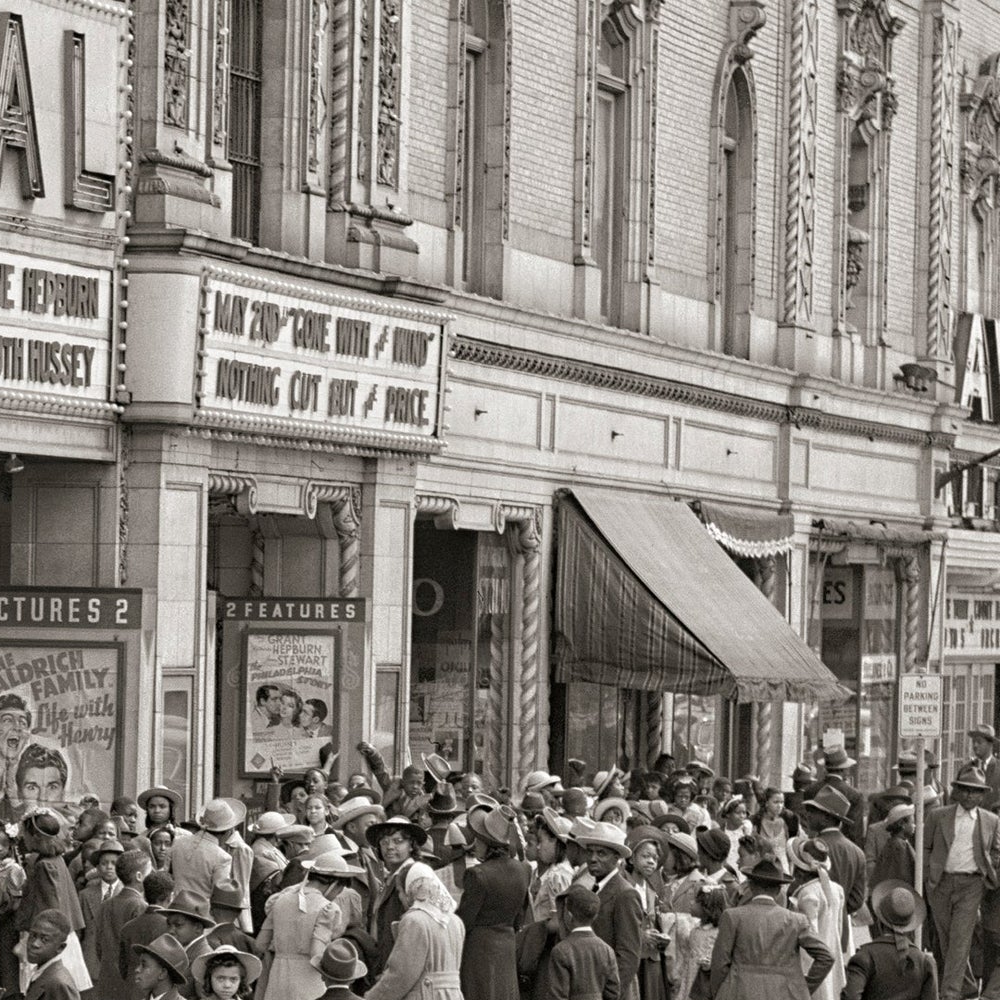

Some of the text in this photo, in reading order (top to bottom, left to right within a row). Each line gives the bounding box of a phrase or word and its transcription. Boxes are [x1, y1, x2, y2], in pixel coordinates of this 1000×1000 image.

[22, 267, 99, 319] HEPBURN
[214, 290, 249, 336] MAY
[249, 300, 280, 343] 2ND
[336, 317, 371, 359] WITH
[28, 339, 96, 387] HUSSEY
[955, 312, 1000, 424] A
[216, 358, 281, 407] NOTHING
[328, 378, 358, 417] BUT
[384, 386, 429, 427] PRICE
[822, 581, 846, 605] ES
[115, 599, 128, 624] 2
[226, 603, 356, 619] 2 FEATURES
[267, 635, 305, 645] GRANT
[273, 644, 322, 655] HEPBURN
[278, 655, 327, 666] STEWART
[31, 667, 110, 701] FAMILY
[251, 668, 322, 681] PHILADELPHIA
[916, 680, 927, 688] NO
[903, 692, 939, 700] PARKING
[31, 693, 114, 735] Life with
[903, 705, 938, 713] BETWEEN
[909, 717, 932, 725] SIGNS
[58, 721, 116, 750] Henry
